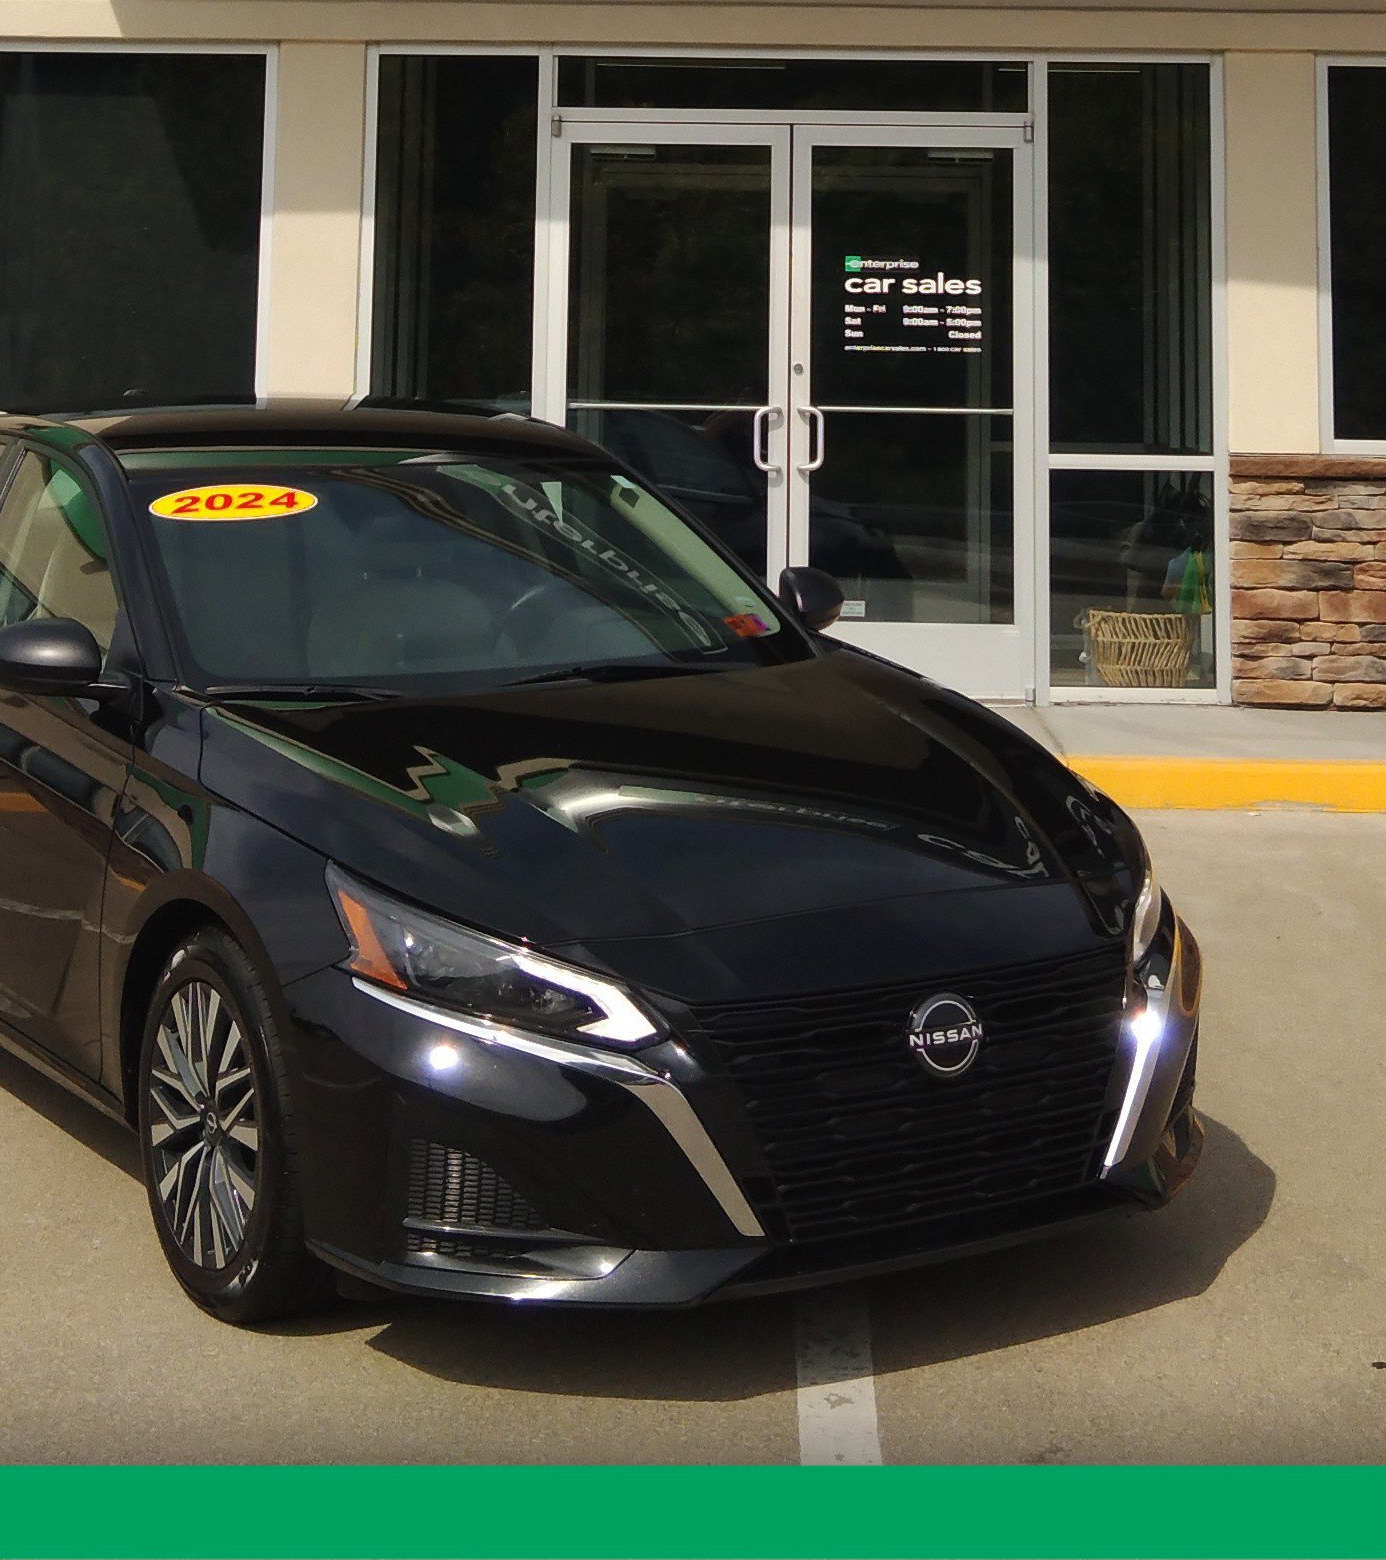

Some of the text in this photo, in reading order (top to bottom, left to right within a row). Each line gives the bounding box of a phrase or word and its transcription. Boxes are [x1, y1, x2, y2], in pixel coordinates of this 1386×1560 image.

[845, 258, 920, 271] enterprise
[844, 272, 982, 295] car sales
[948, 330, 982, 340] Closed
[172, 491, 299, 515] 2024
[909, 1023, 983, 1047] NISSAN
